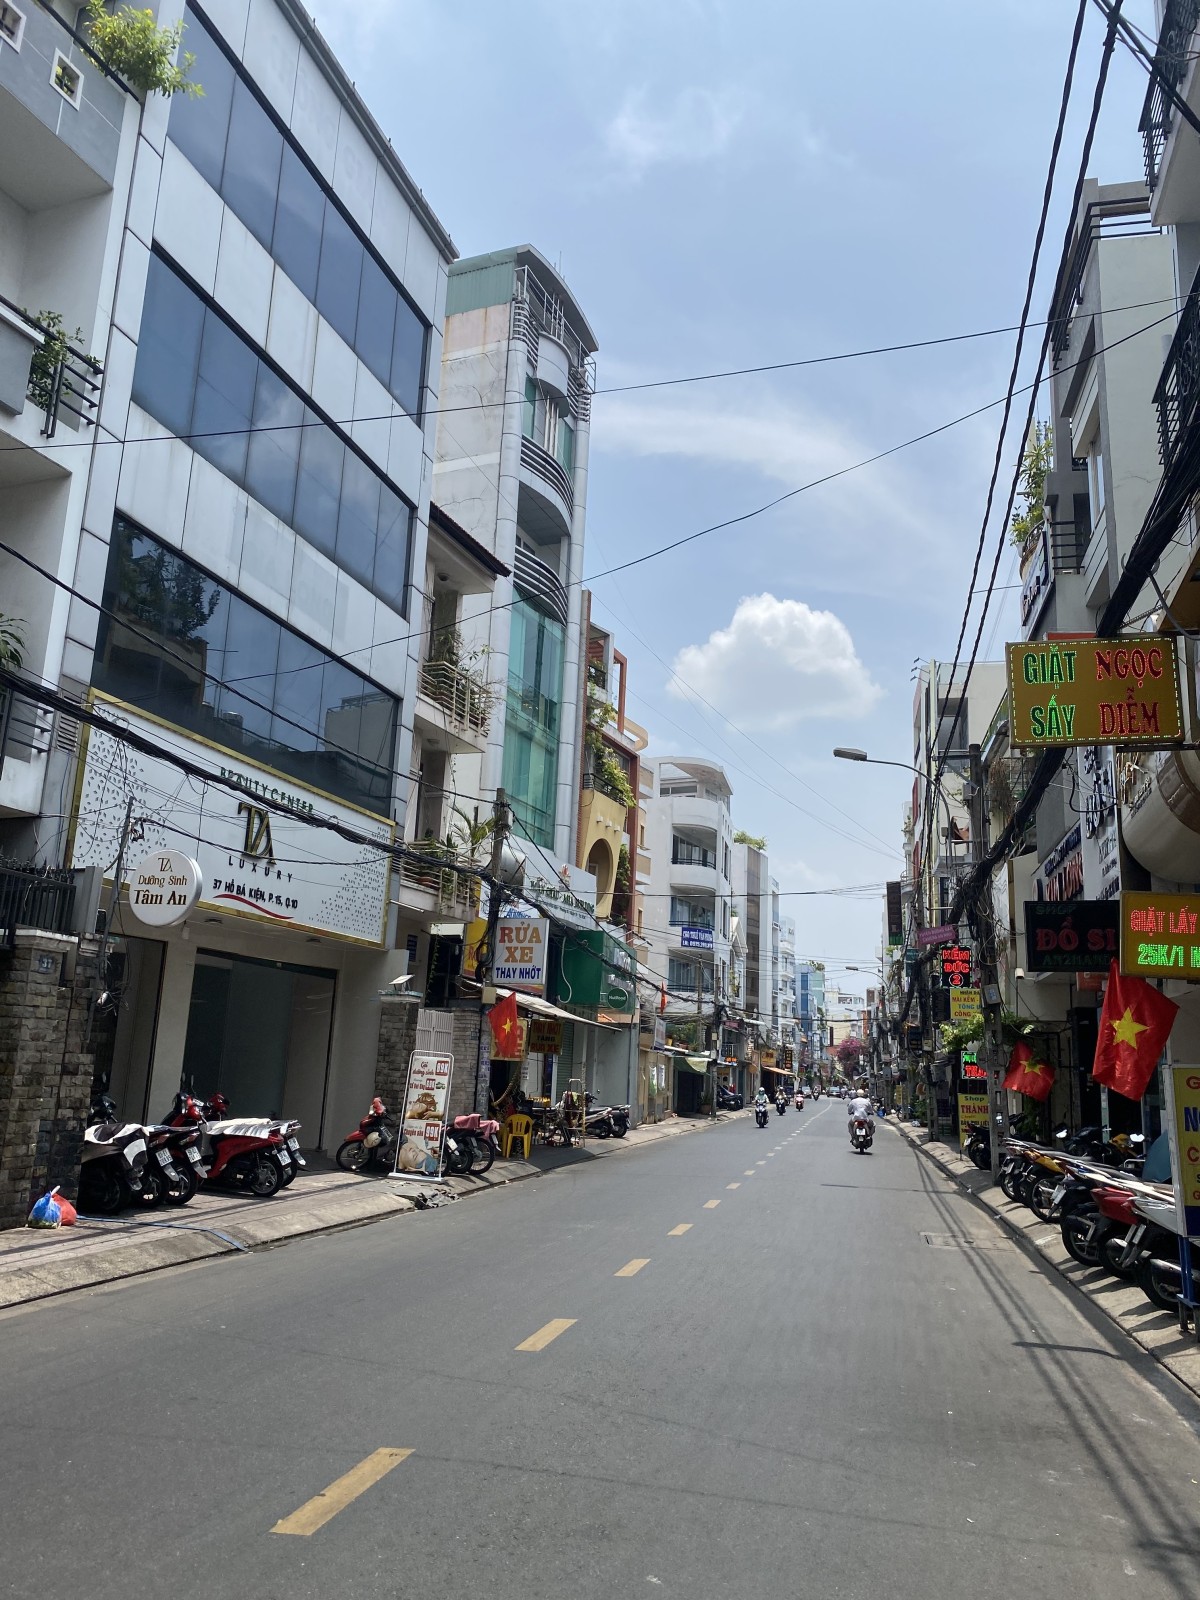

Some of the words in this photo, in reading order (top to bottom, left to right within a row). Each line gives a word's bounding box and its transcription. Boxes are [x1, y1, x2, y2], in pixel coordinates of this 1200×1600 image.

[1022, 646, 1077, 690] GIẶT
[1095, 648, 1163, 688] NGỌC
[1029, 694, 1076, 738] SẤY
[1099, 686, 1160, 736] DIỄM
[220, 767, 268, 797] BEAUTY
[270, 788, 314, 813] CENTER
[228, 855, 293, 883] LUXURY
[138, 875, 165, 888] Dưỡng
[168, 875, 187, 886] Sinh
[213, 879, 222, 890] 37
[236, 884, 246, 897] BÁ
[133, 890, 165, 905] Tâm
[166, 891, 187, 905] An
[1130, 906, 1166, 937] GIẶT
[1169, 905, 1198, 934] LẤY
[499, 921, 542, 943] RỬA
[1087, 927, 1117, 951] SI
[504, 946, 534, 963] XE
[1137, 943, 1184, 966] 25K/1
[496, 967, 517, 979] THAY
[518, 964, 542, 980] NHỚT
[943, 960, 970, 973] ĐỨC
[952, 974, 961, 985] 2
[964, 1095, 985, 1103] Shop
